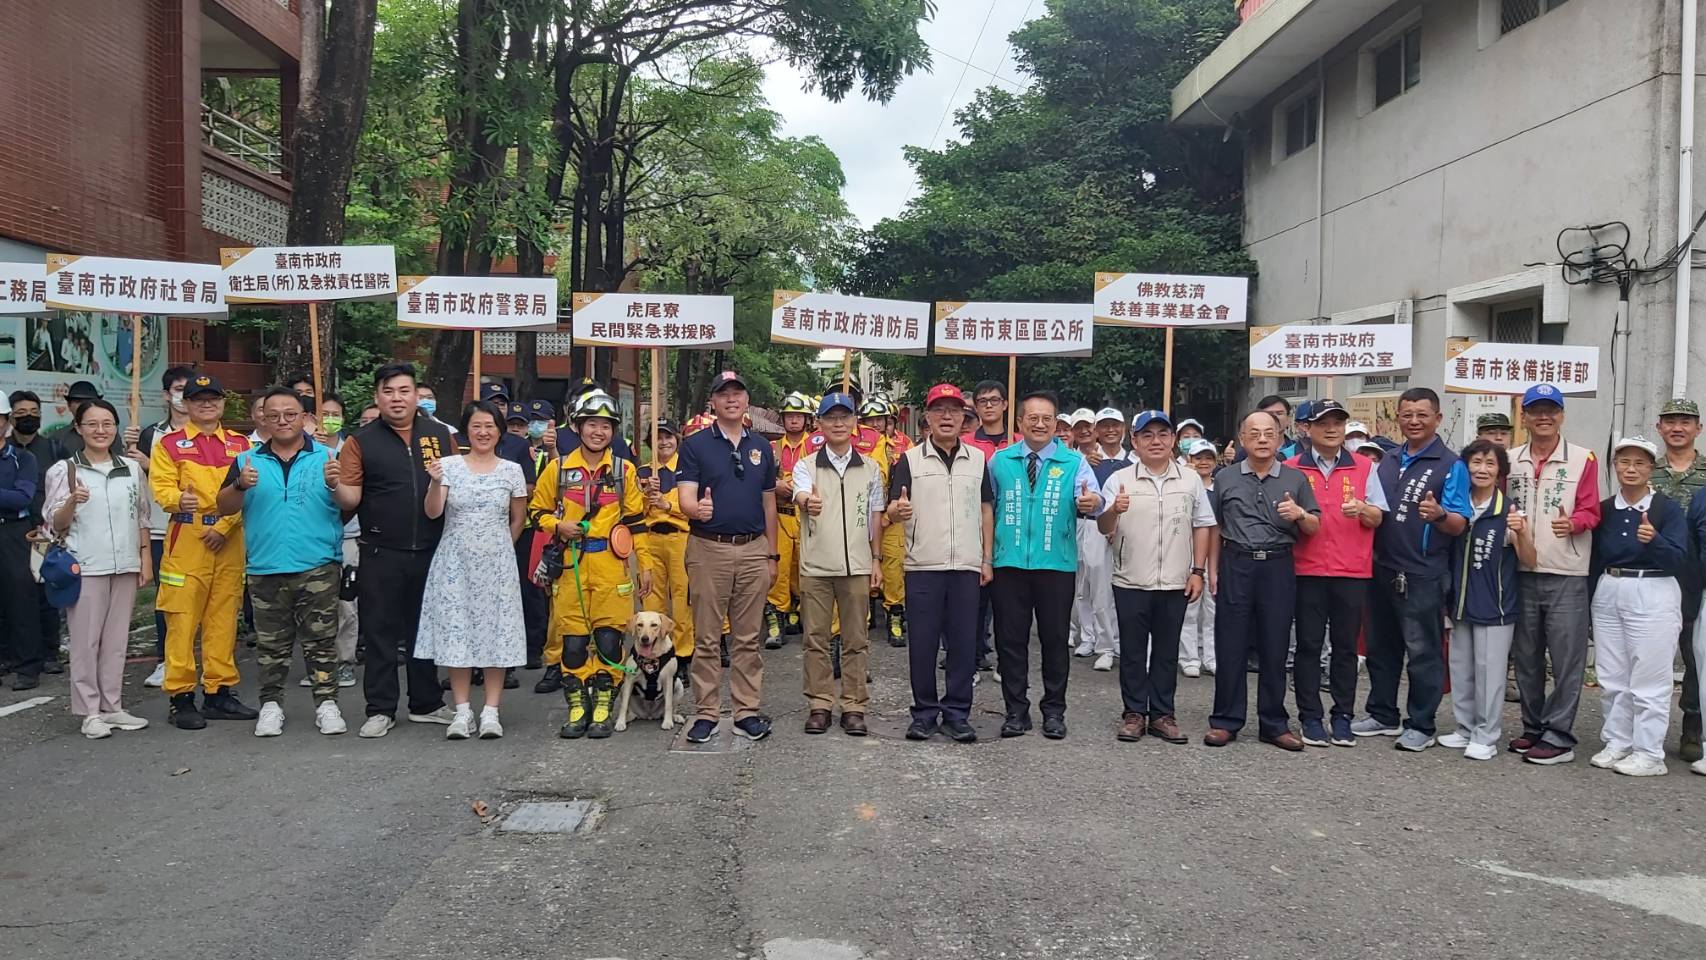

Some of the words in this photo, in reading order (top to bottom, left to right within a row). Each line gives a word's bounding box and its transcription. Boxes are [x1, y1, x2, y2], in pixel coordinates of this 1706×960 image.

[275, 252, 342, 269] 臺南市政府
[57, 271, 218, 304] 臺南市政府社會局
[228, 272, 391, 293] 衛生局(所)及急救責任醫院
[1137, 282, 1206, 300] 佛教慈濟
[407, 291, 547, 317] 臺南市政府警察局
[627, 302, 680, 318] 虎尾寮
[1109, 301, 1231, 321] 慈善事業基金會
[590, 322, 717, 341] 民間緊急救援隊
[781, 306, 919, 341] 臺南市政府消防局
[943, 315, 1084, 342] 臺南市東區區公所
[1284, 332, 1375, 348] 臺南市政府
[1266, 352, 1394, 369] 災害防救辦公室
[1454, 355, 1589, 385] 臺南市後備指揮部
